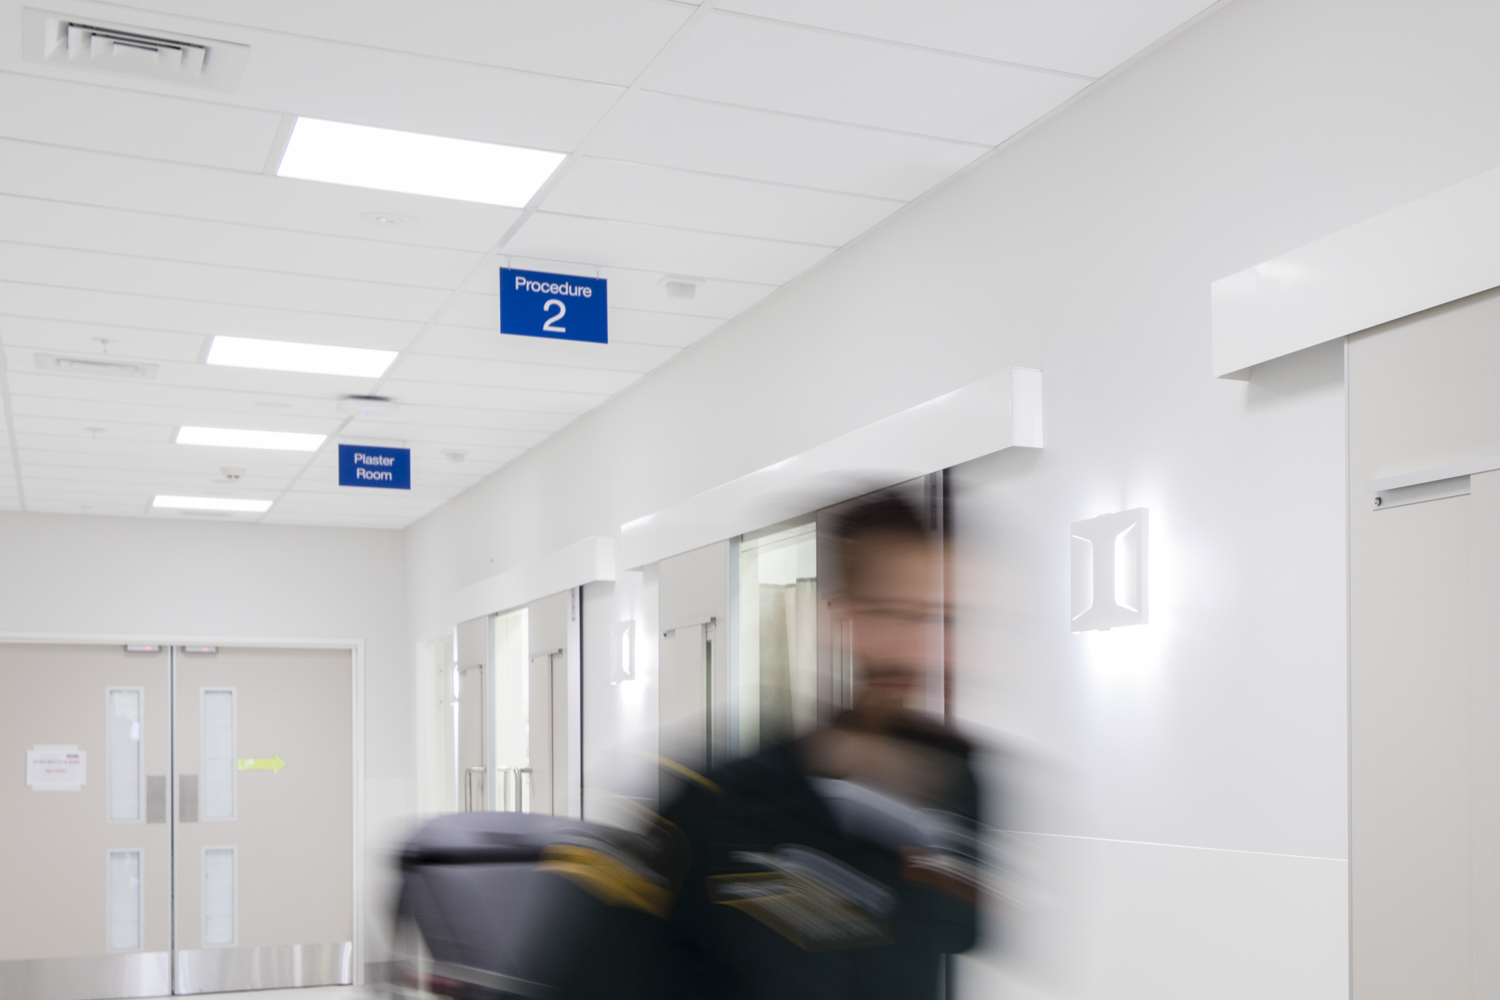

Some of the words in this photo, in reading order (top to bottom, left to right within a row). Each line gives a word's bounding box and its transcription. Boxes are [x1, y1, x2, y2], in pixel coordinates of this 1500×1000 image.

[515, 276, 592, 298] Procedure
[542, 298, 567, 333] 2
[354, 452, 395, 467] Plaster
[356, 467, 393, 481] Room
